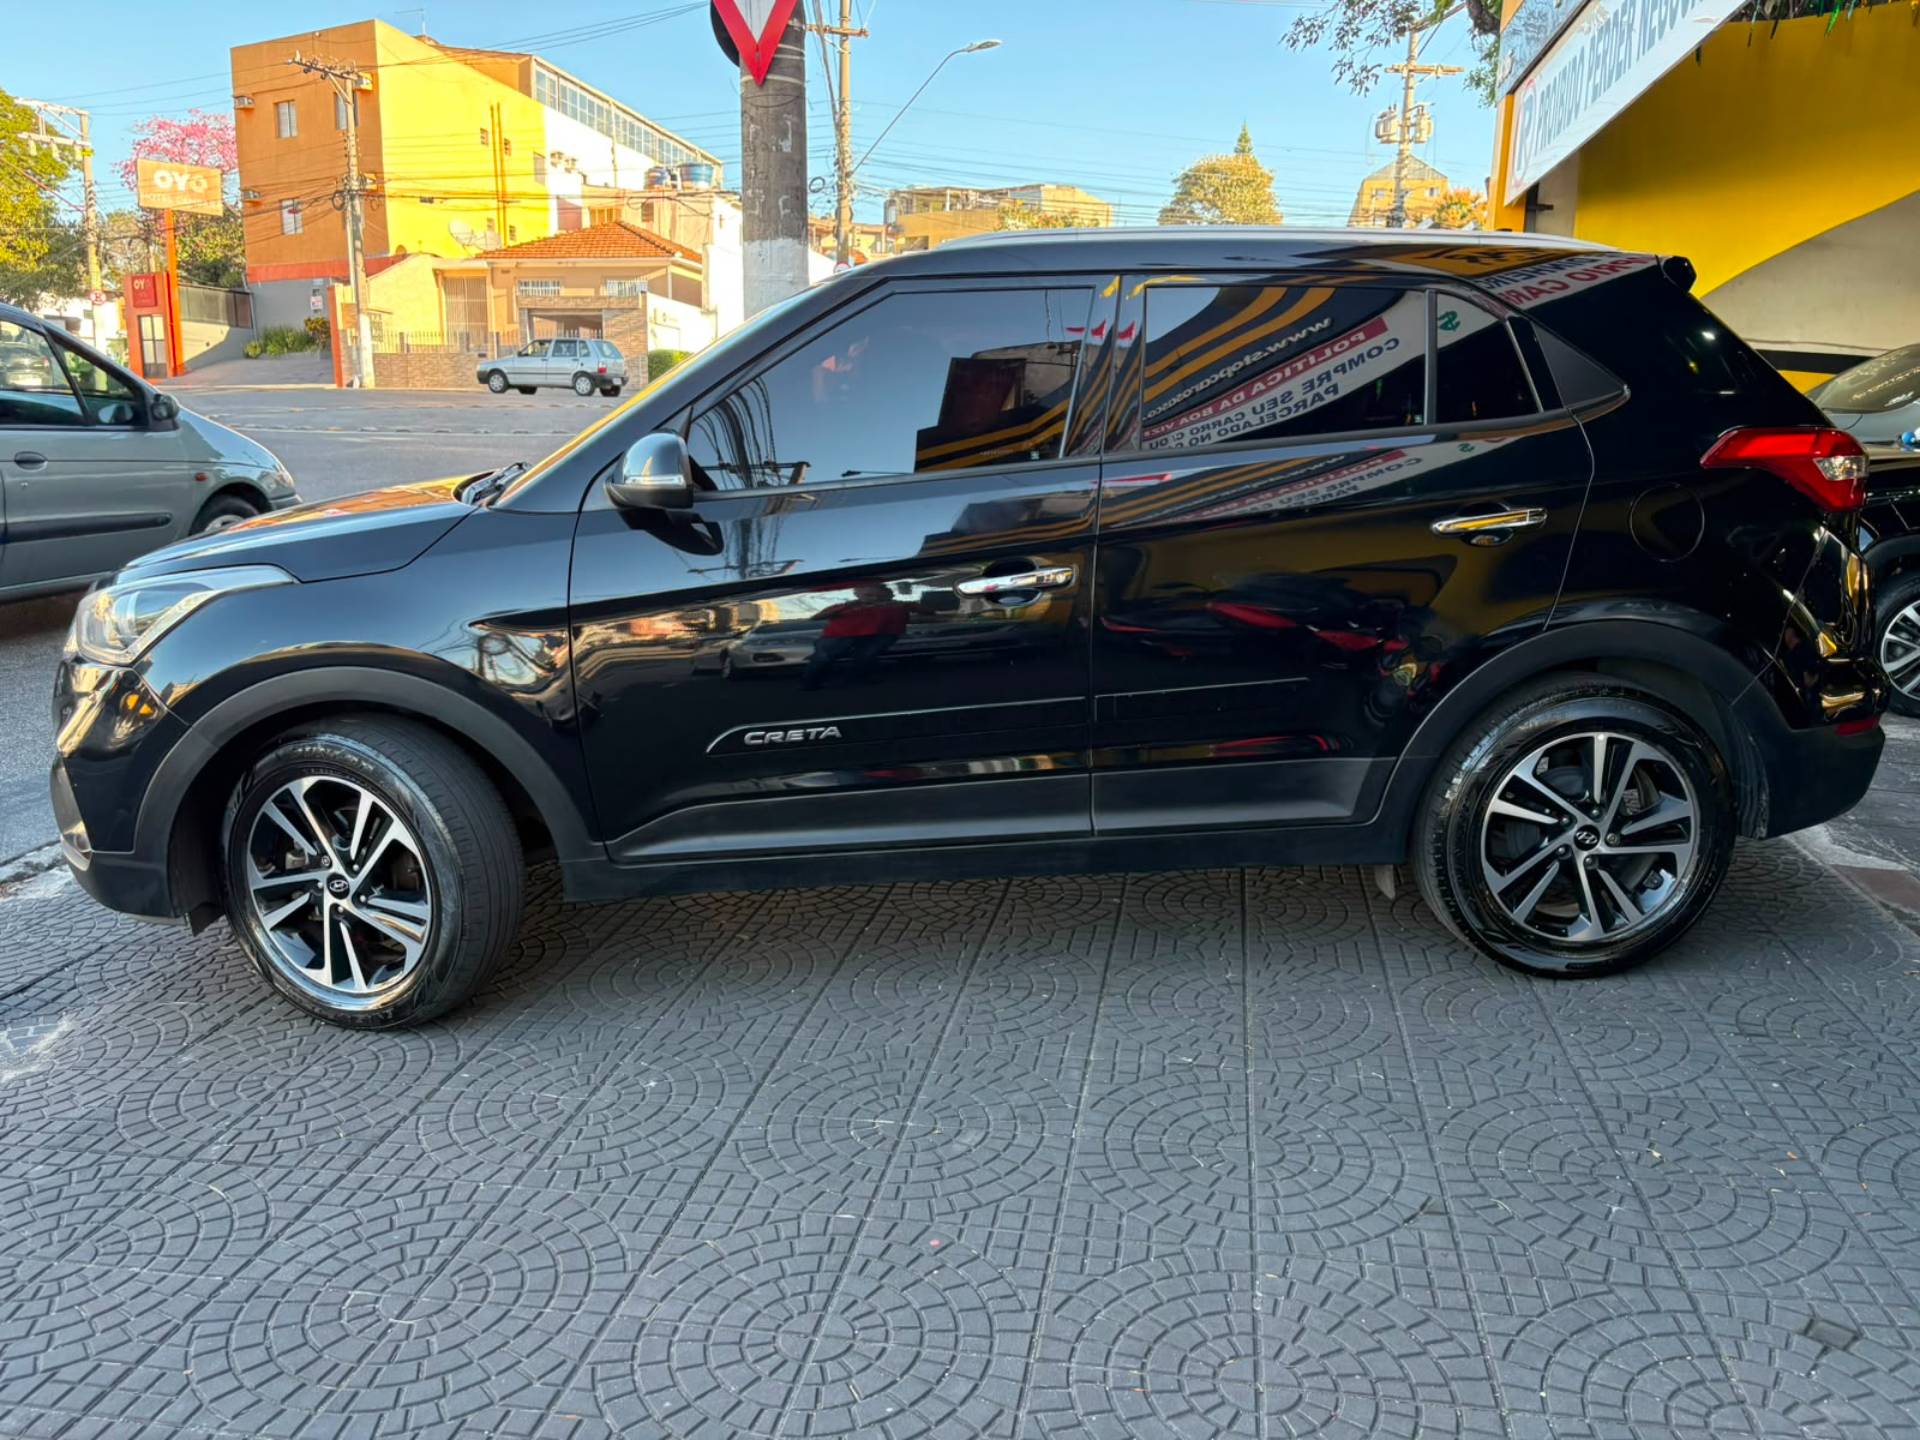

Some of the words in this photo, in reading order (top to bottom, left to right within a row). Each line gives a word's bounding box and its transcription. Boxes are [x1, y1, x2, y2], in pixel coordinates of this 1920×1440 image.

[1534, 45, 1585, 157] PROIBIDO
[1583, 0, 1637, 112] PERDER
[153, 169, 208, 193] OYO
[744, 726, 842, 745] CRETA
